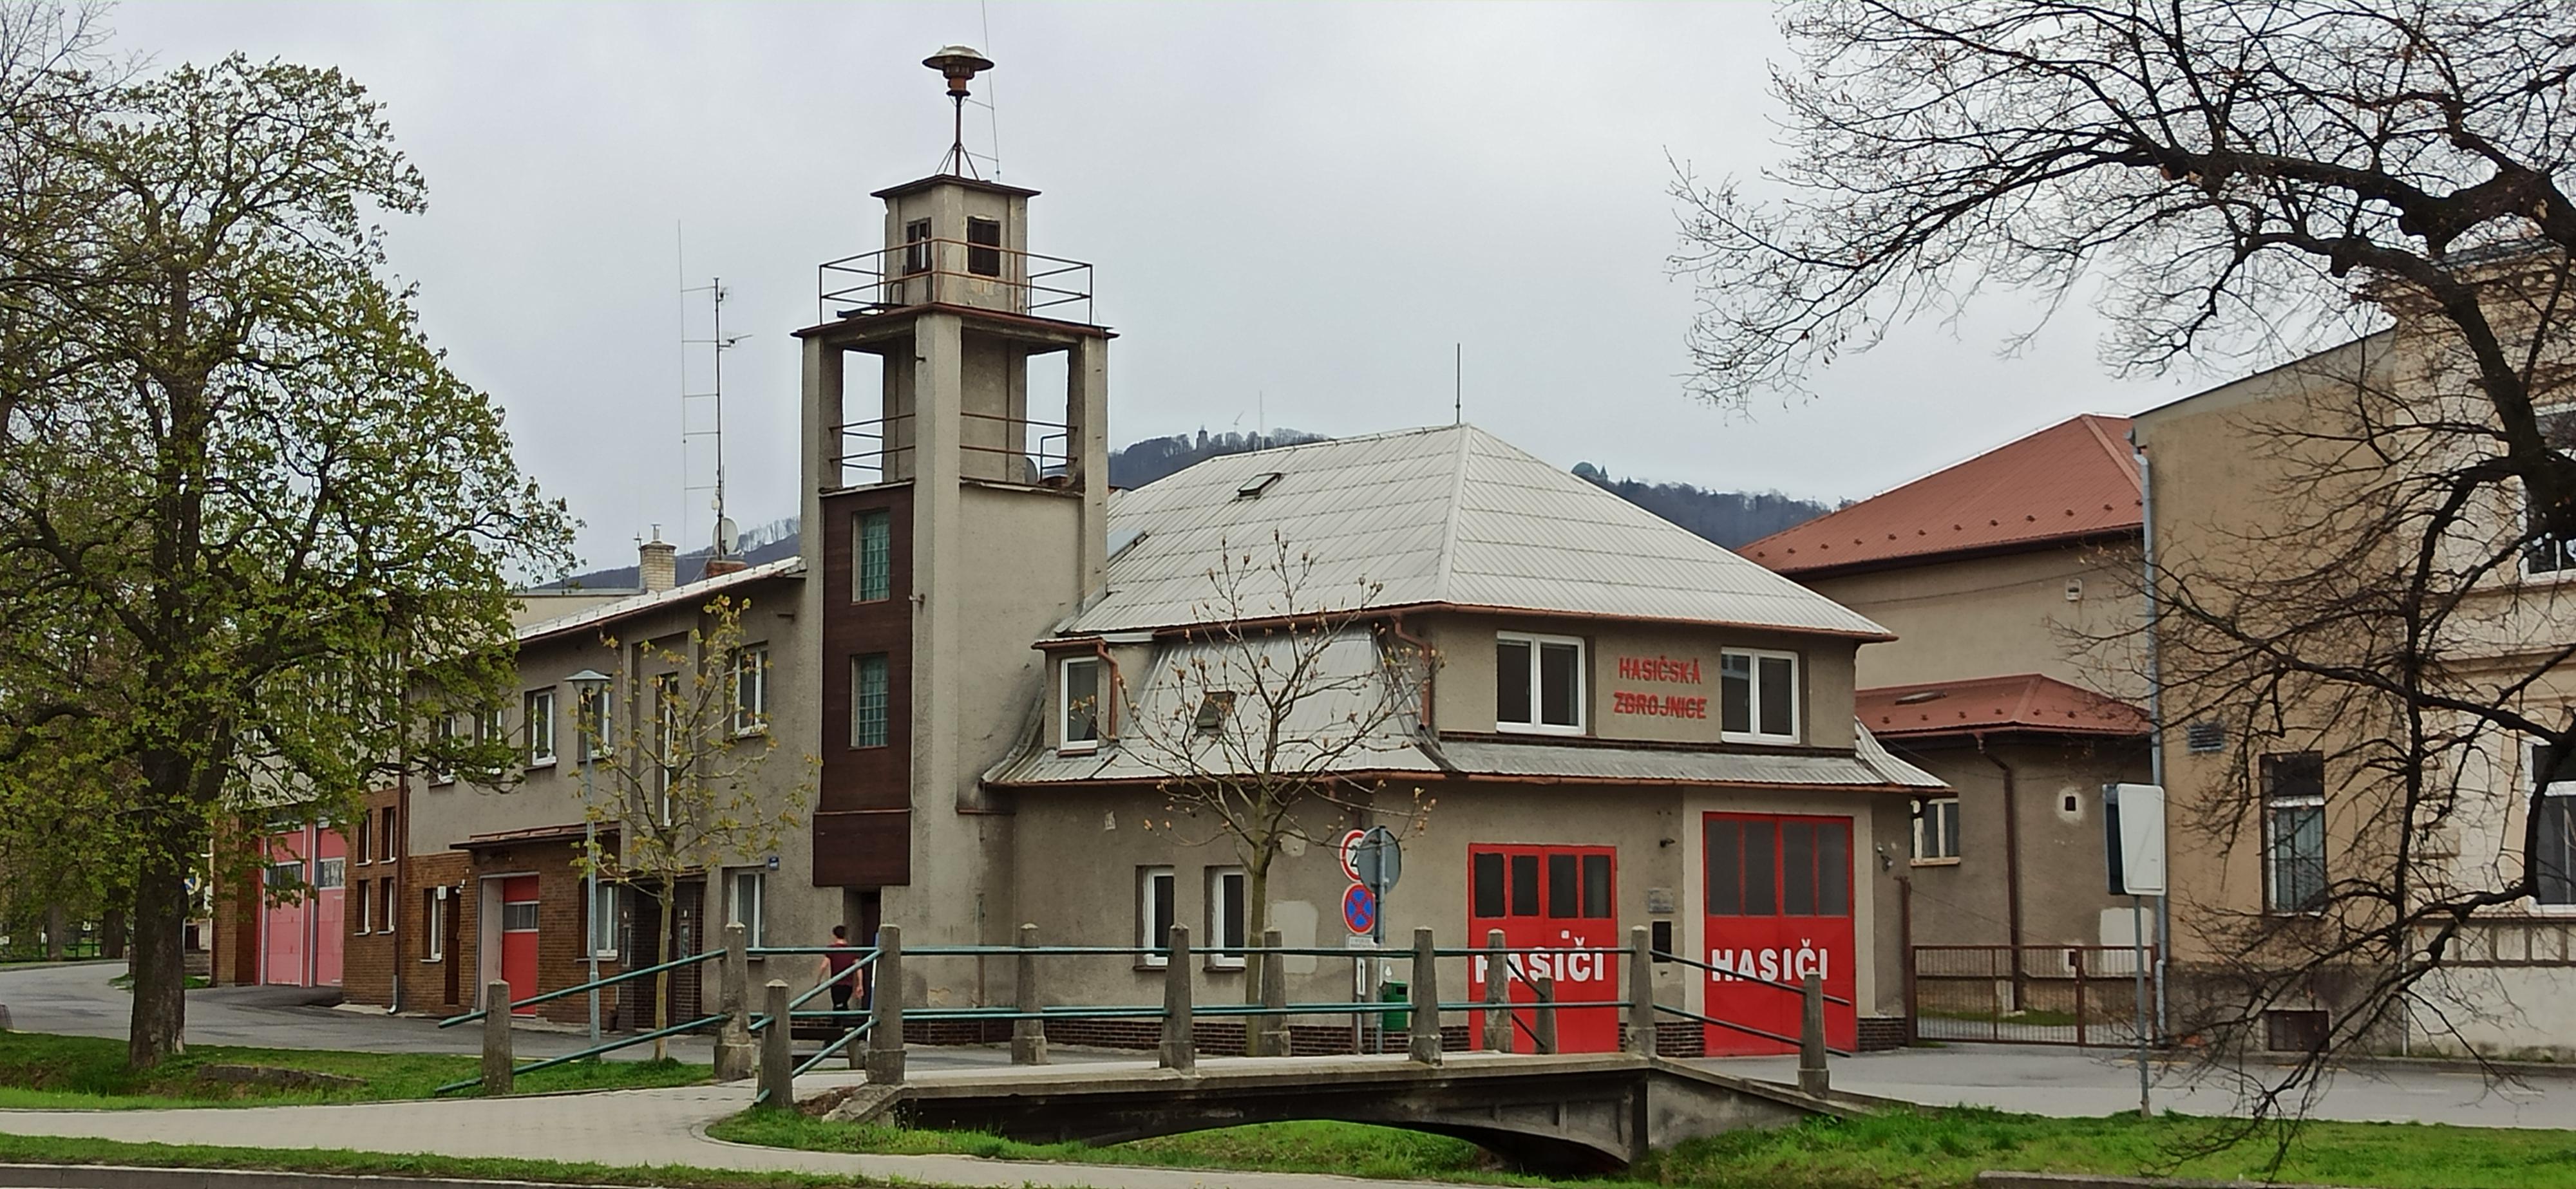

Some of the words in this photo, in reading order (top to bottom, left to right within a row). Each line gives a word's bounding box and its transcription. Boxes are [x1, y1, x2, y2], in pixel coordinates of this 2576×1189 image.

[1618, 655, 1702, 685] HASIČSKÁ
[1613, 691, 1708, 720] ZBROJNICE
[1712, 938, 1828, 982] HASIČI
